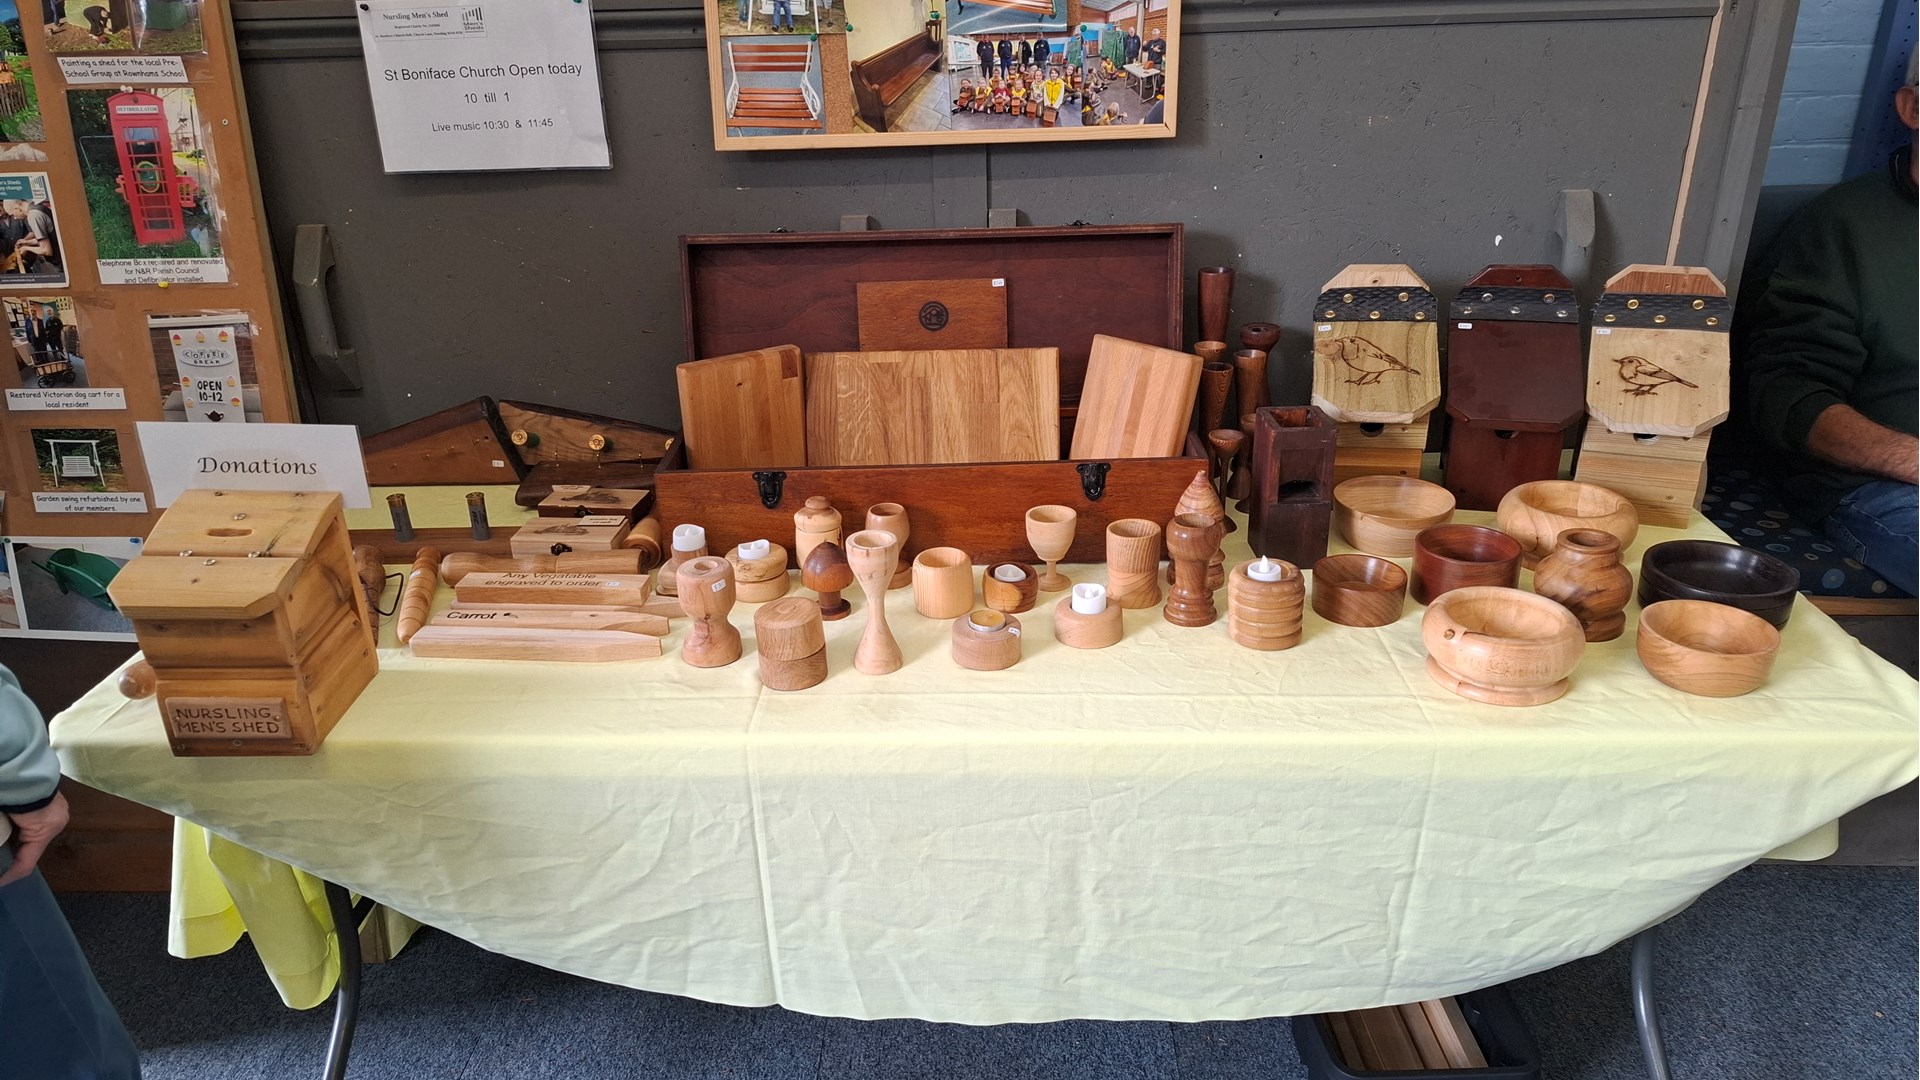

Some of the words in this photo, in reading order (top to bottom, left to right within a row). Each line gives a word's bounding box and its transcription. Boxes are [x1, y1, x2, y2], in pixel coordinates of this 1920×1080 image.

[383, 12, 411, 21] Nursling
[412, 11, 432, 19] Men's
[432, 10, 449, 18] Shed
[61, 58, 92, 68] Painting
[98, 58, 116, 66] shed
[117, 58, 129, 66] for
[131, 58, 143, 66] the
[145, 58, 161, 66] local
[162, 58, 179, 66] Pre-
[65, 70, 90, 78] School
[91, 69, 113, 78] Group
[122, 69, 159, 77] Rownhams
[160, 69, 185, 77] School
[384, 69, 399, 81] St
[402, 67, 456, 81] Boniface
[459, 65, 505, 78] Church
[509, 63, 545, 78] Open
[547, 62, 582, 77] today
[464, 92, 478, 104] 10
[484, 92, 497, 103] till
[503, 91, 510, 102] 1
[431, 121, 451, 132] Live
[453, 121, 481, 131] music
[483, 120, 510, 130] 10:30
[515, 119, 522, 129] &
[528, 118, 554, 128] 11:45
[100, 259, 132, 268] Telephone
[148, 258, 175, 268] repaired
[137, 276, 175, 284] Defibrator
[184, 350, 226, 359] COFFEE
[197, 380, 223, 391] OPEN
[10, 391, 42, 399] Restored
[75, 391, 87, 399] dog
[198, 391, 224, 402] 10-12
[197, 456, 317, 475] Donations
[61, 495, 79, 503] swing
[119, 495, 128, 503] by
[502, 572, 529, 580] Any
[484, 579, 547, 587] engraved
[566, 579, 602, 587] order
[446, 611, 497, 620] Carrot
[175, 707, 271, 719] NURSLING
[177, 721, 226, 733] MEN'S
[232, 721, 280, 734] SHED
